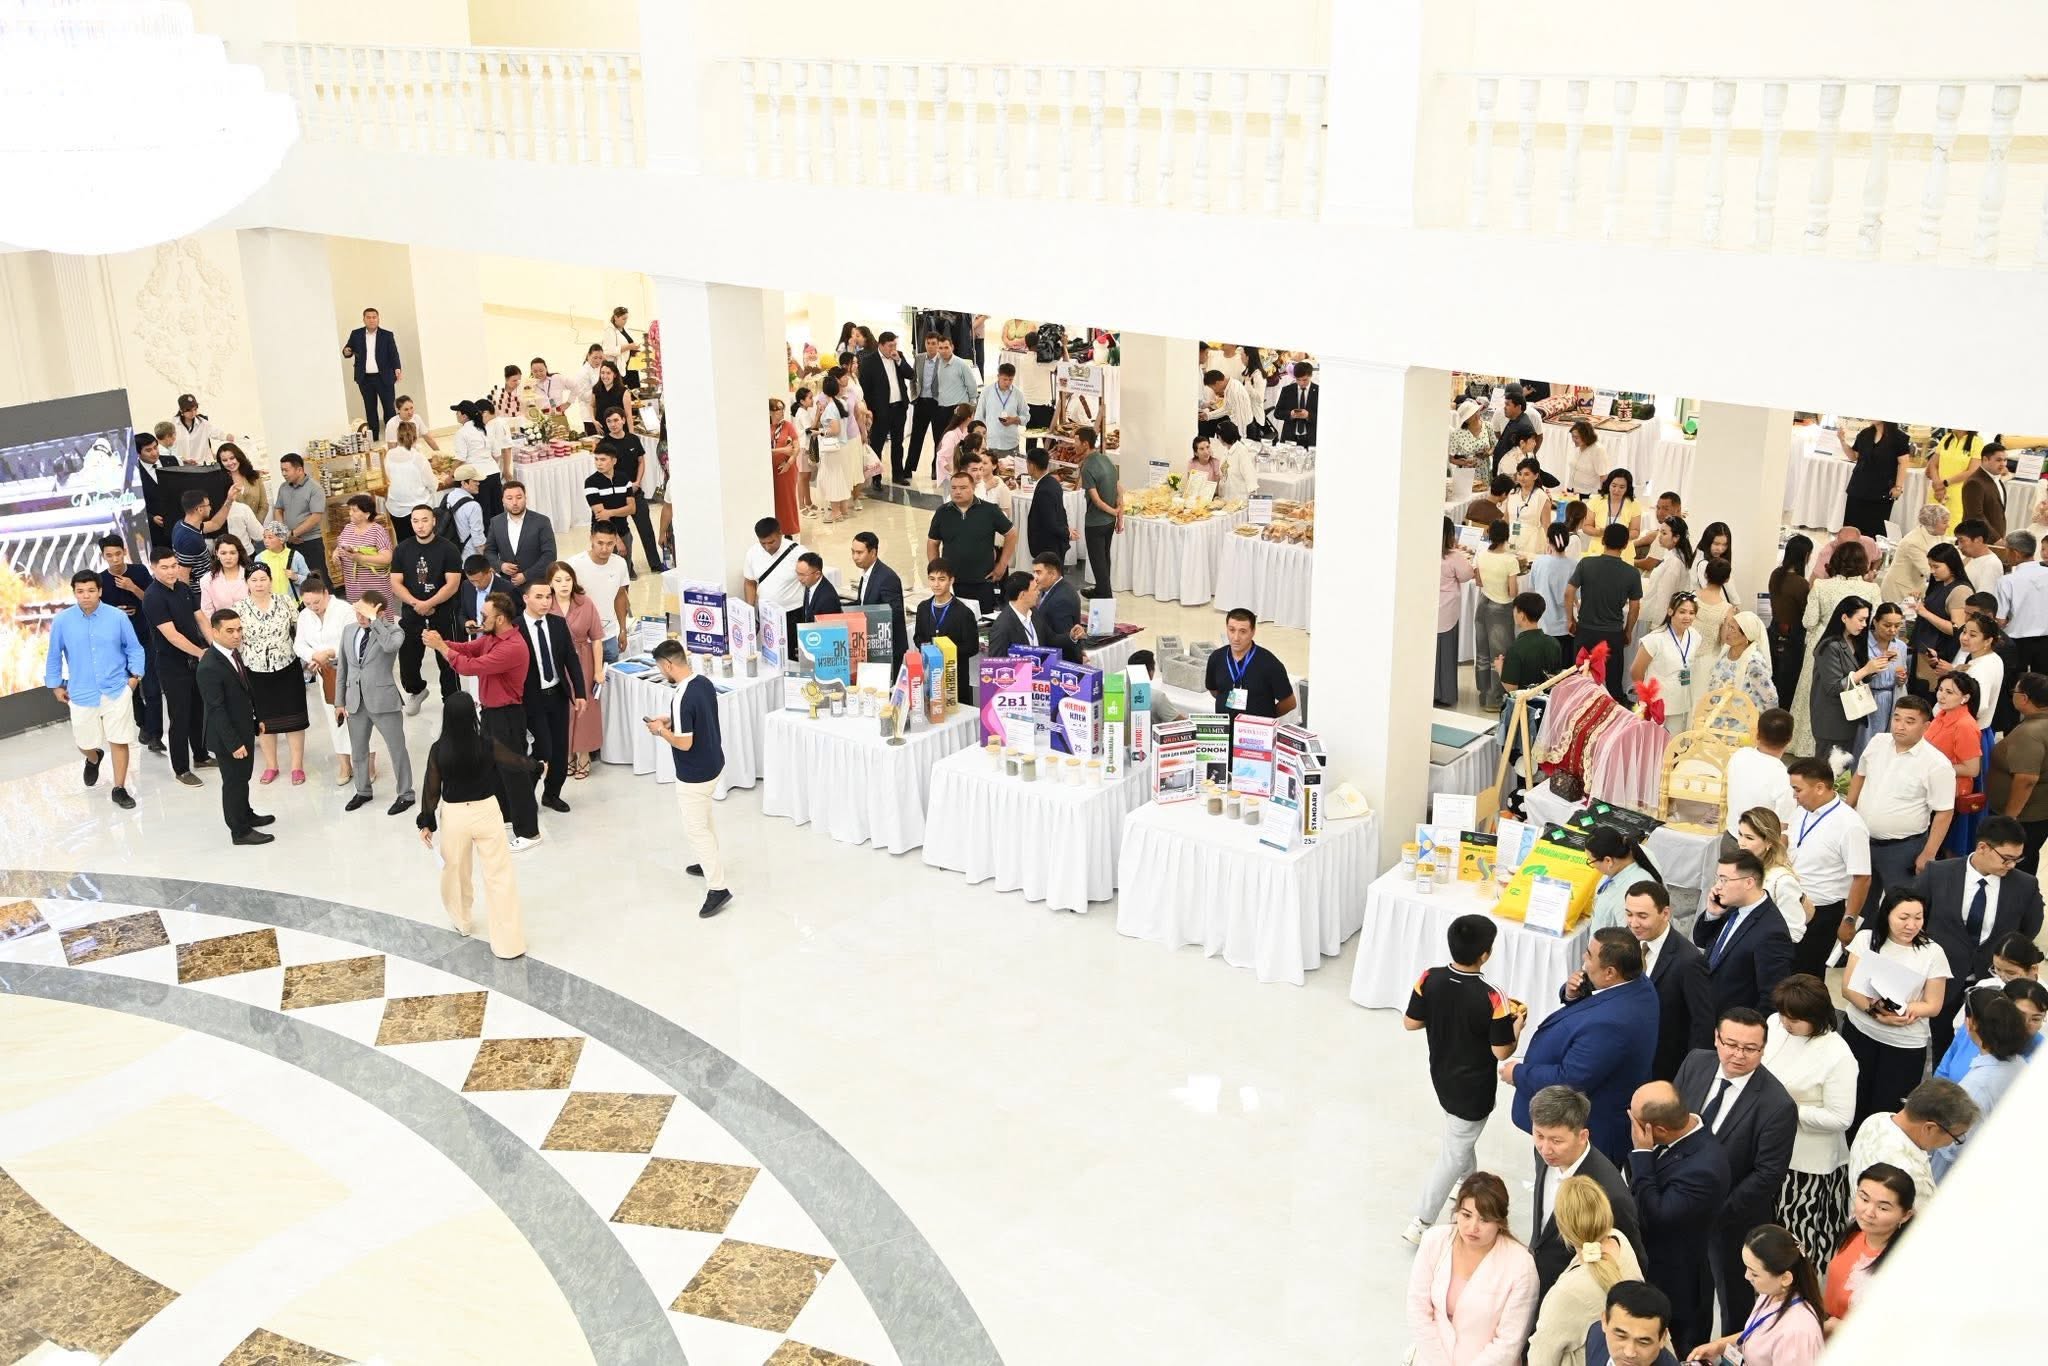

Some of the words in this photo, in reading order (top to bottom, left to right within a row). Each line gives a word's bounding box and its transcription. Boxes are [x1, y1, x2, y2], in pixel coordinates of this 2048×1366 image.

[694, 633, 713, 644] 450
[1031, 683, 1051, 692] EGA
[1031, 692, 1050, 700] LOCK
